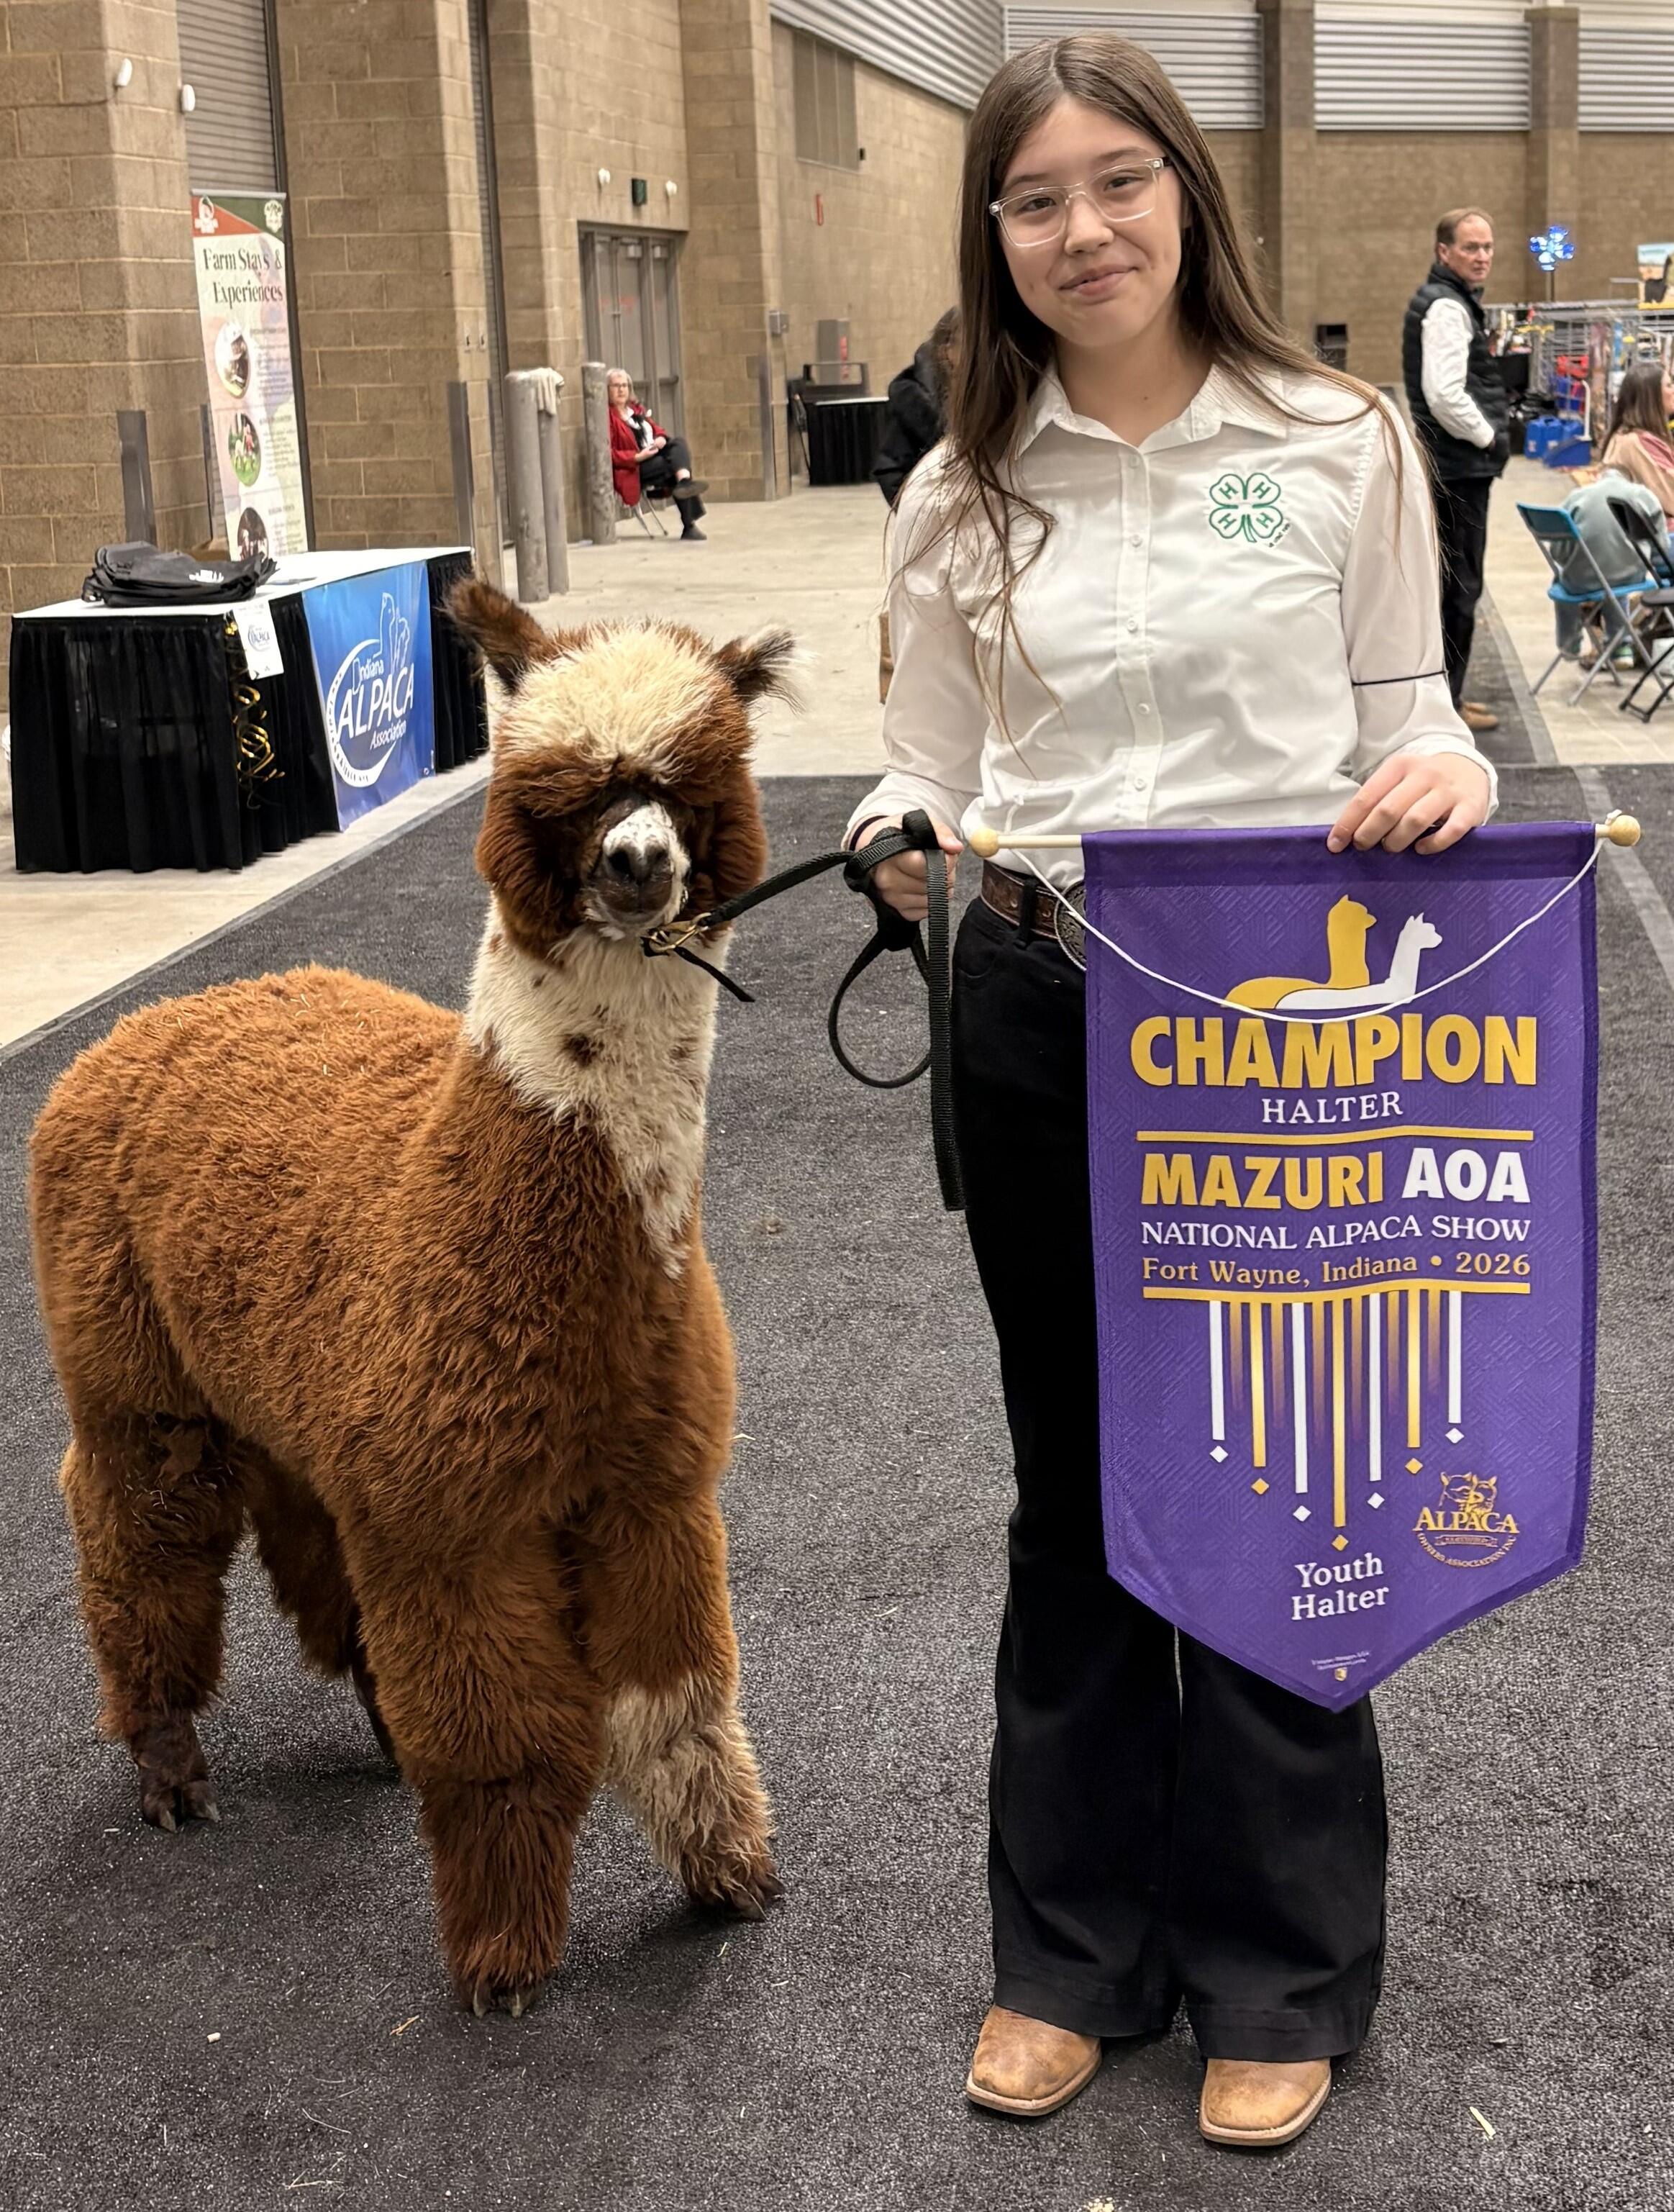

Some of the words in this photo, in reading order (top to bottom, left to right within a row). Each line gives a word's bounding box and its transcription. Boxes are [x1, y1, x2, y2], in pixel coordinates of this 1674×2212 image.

[203, 248, 237, 270] Farm
[213, 279, 283, 309] Experiences
[337, 663, 414, 740] ALPACA
[370, 720, 406, 751] Association
[1130, 1013, 1537, 1088] CHAMPION
[1262, 1091, 1404, 1124] HALTER
[1141, 1151, 1383, 1210] MAZURI
[1401, 1148, 1530, 1203] AOA
[1141, 1221, 1297, 1250] NATIONAL
[1305, 1215, 1421, 1249] ALPACA
[1431, 1215, 1531, 1242] SHOW
[1142, 1257, 1199, 1282] Fort
[1209, 1260, 1311, 1288] Wayne,
[1322, 1255, 1418, 1282] Indiana
[1456, 1252, 1531, 1276] 2026
[1412, 1507, 1520, 1533] ALPACA
[1295, 1553, 1383, 1587] Youth
[1291, 1585, 1389, 1621] Halter
